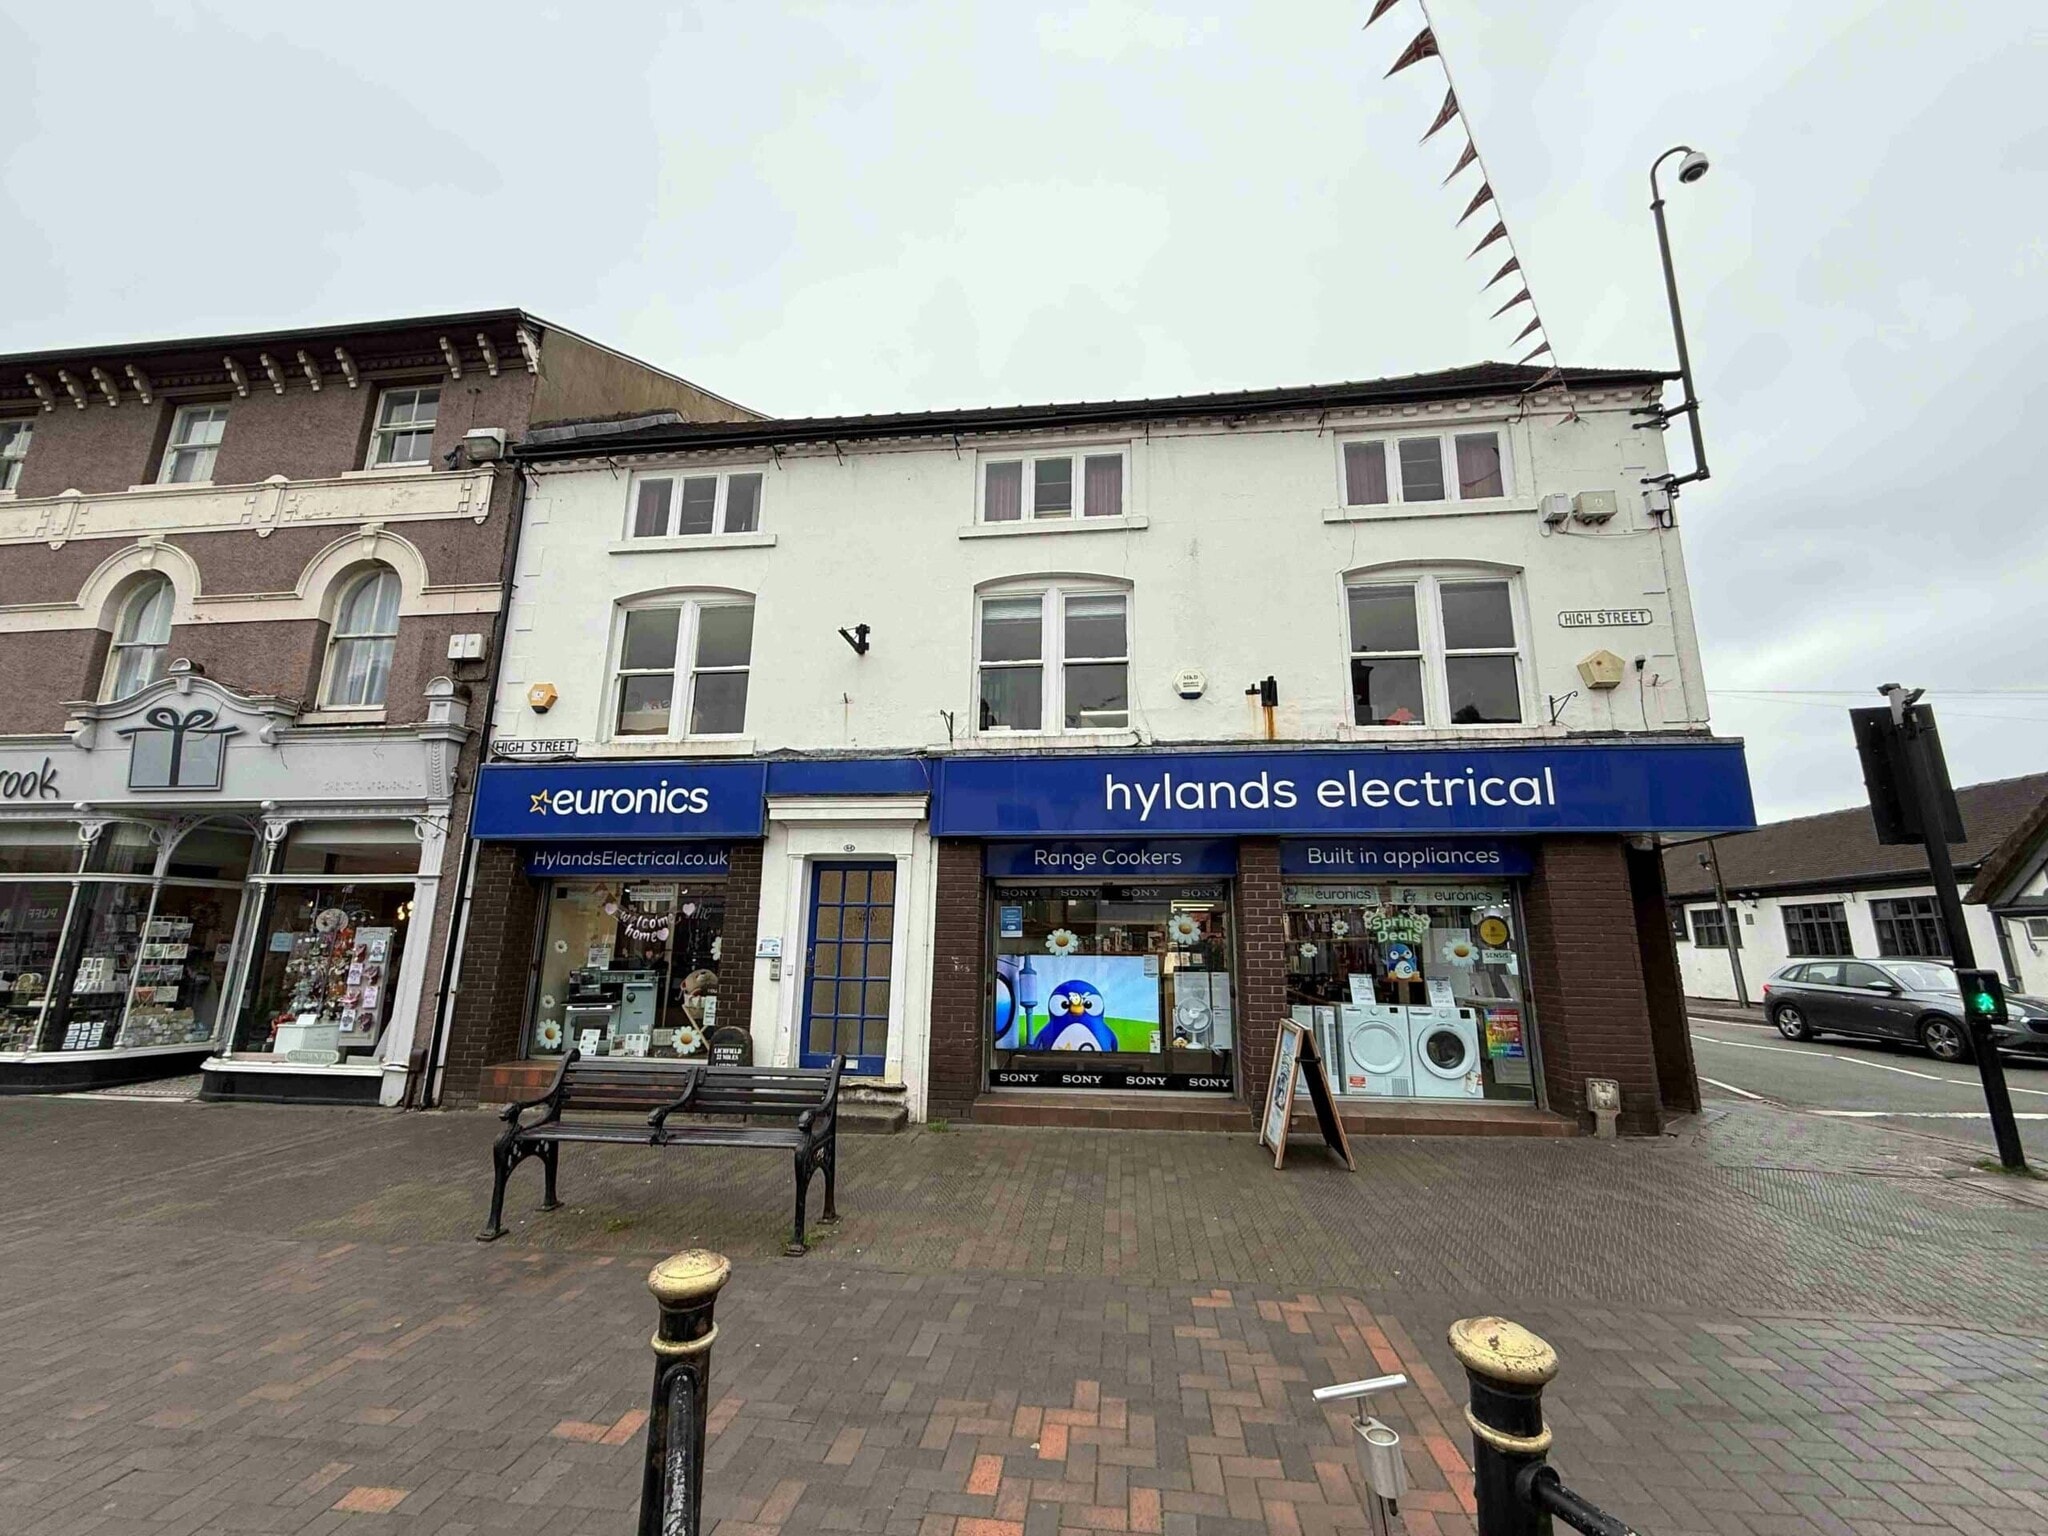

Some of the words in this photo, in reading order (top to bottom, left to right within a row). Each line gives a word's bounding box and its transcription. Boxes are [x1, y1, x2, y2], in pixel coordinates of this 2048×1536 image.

[1564, 612, 1592, 625] HIGH
[1597, 611, 1646, 624] STREET
[496, 742, 524, 753] HIGH
[530, 740, 574, 752] STREET
[552, 780, 709, 815] euronics
[1105, 771, 1297, 821] hylands
[1317, 767, 1555, 807] electrical
[534, 850, 729, 870] HylandsElectrical.co.uk
[1034, 849, 1097, 870] Range
[1102, 849, 1182, 865] Cookers
[1307, 847, 1354, 864] Built
[1360, 848, 1378, 864] in
[1383, 847, 1500, 868] appliances
[1001, 889, 1038, 897] SONY
[1060, 889, 1100, 897] SONY
[1121, 888, 1160, 897] SONY
[1181, 888, 1221, 897] SONY
[1315, 889, 1372, 900] euronics
[1434, 889, 1493, 901] euronics
[620, 910, 674, 929] welcome
[1372, 915, 1425, 934] Spring
[624, 923, 657, 943] home
[1377, 930, 1421, 943] Deals
[999, 1073, 1040, 1083] SONY
[1062, 1074, 1103, 1084] SONY
[1125, 1075, 1167, 1086] SONY
[1188, 1077, 1231, 1088] SONY
